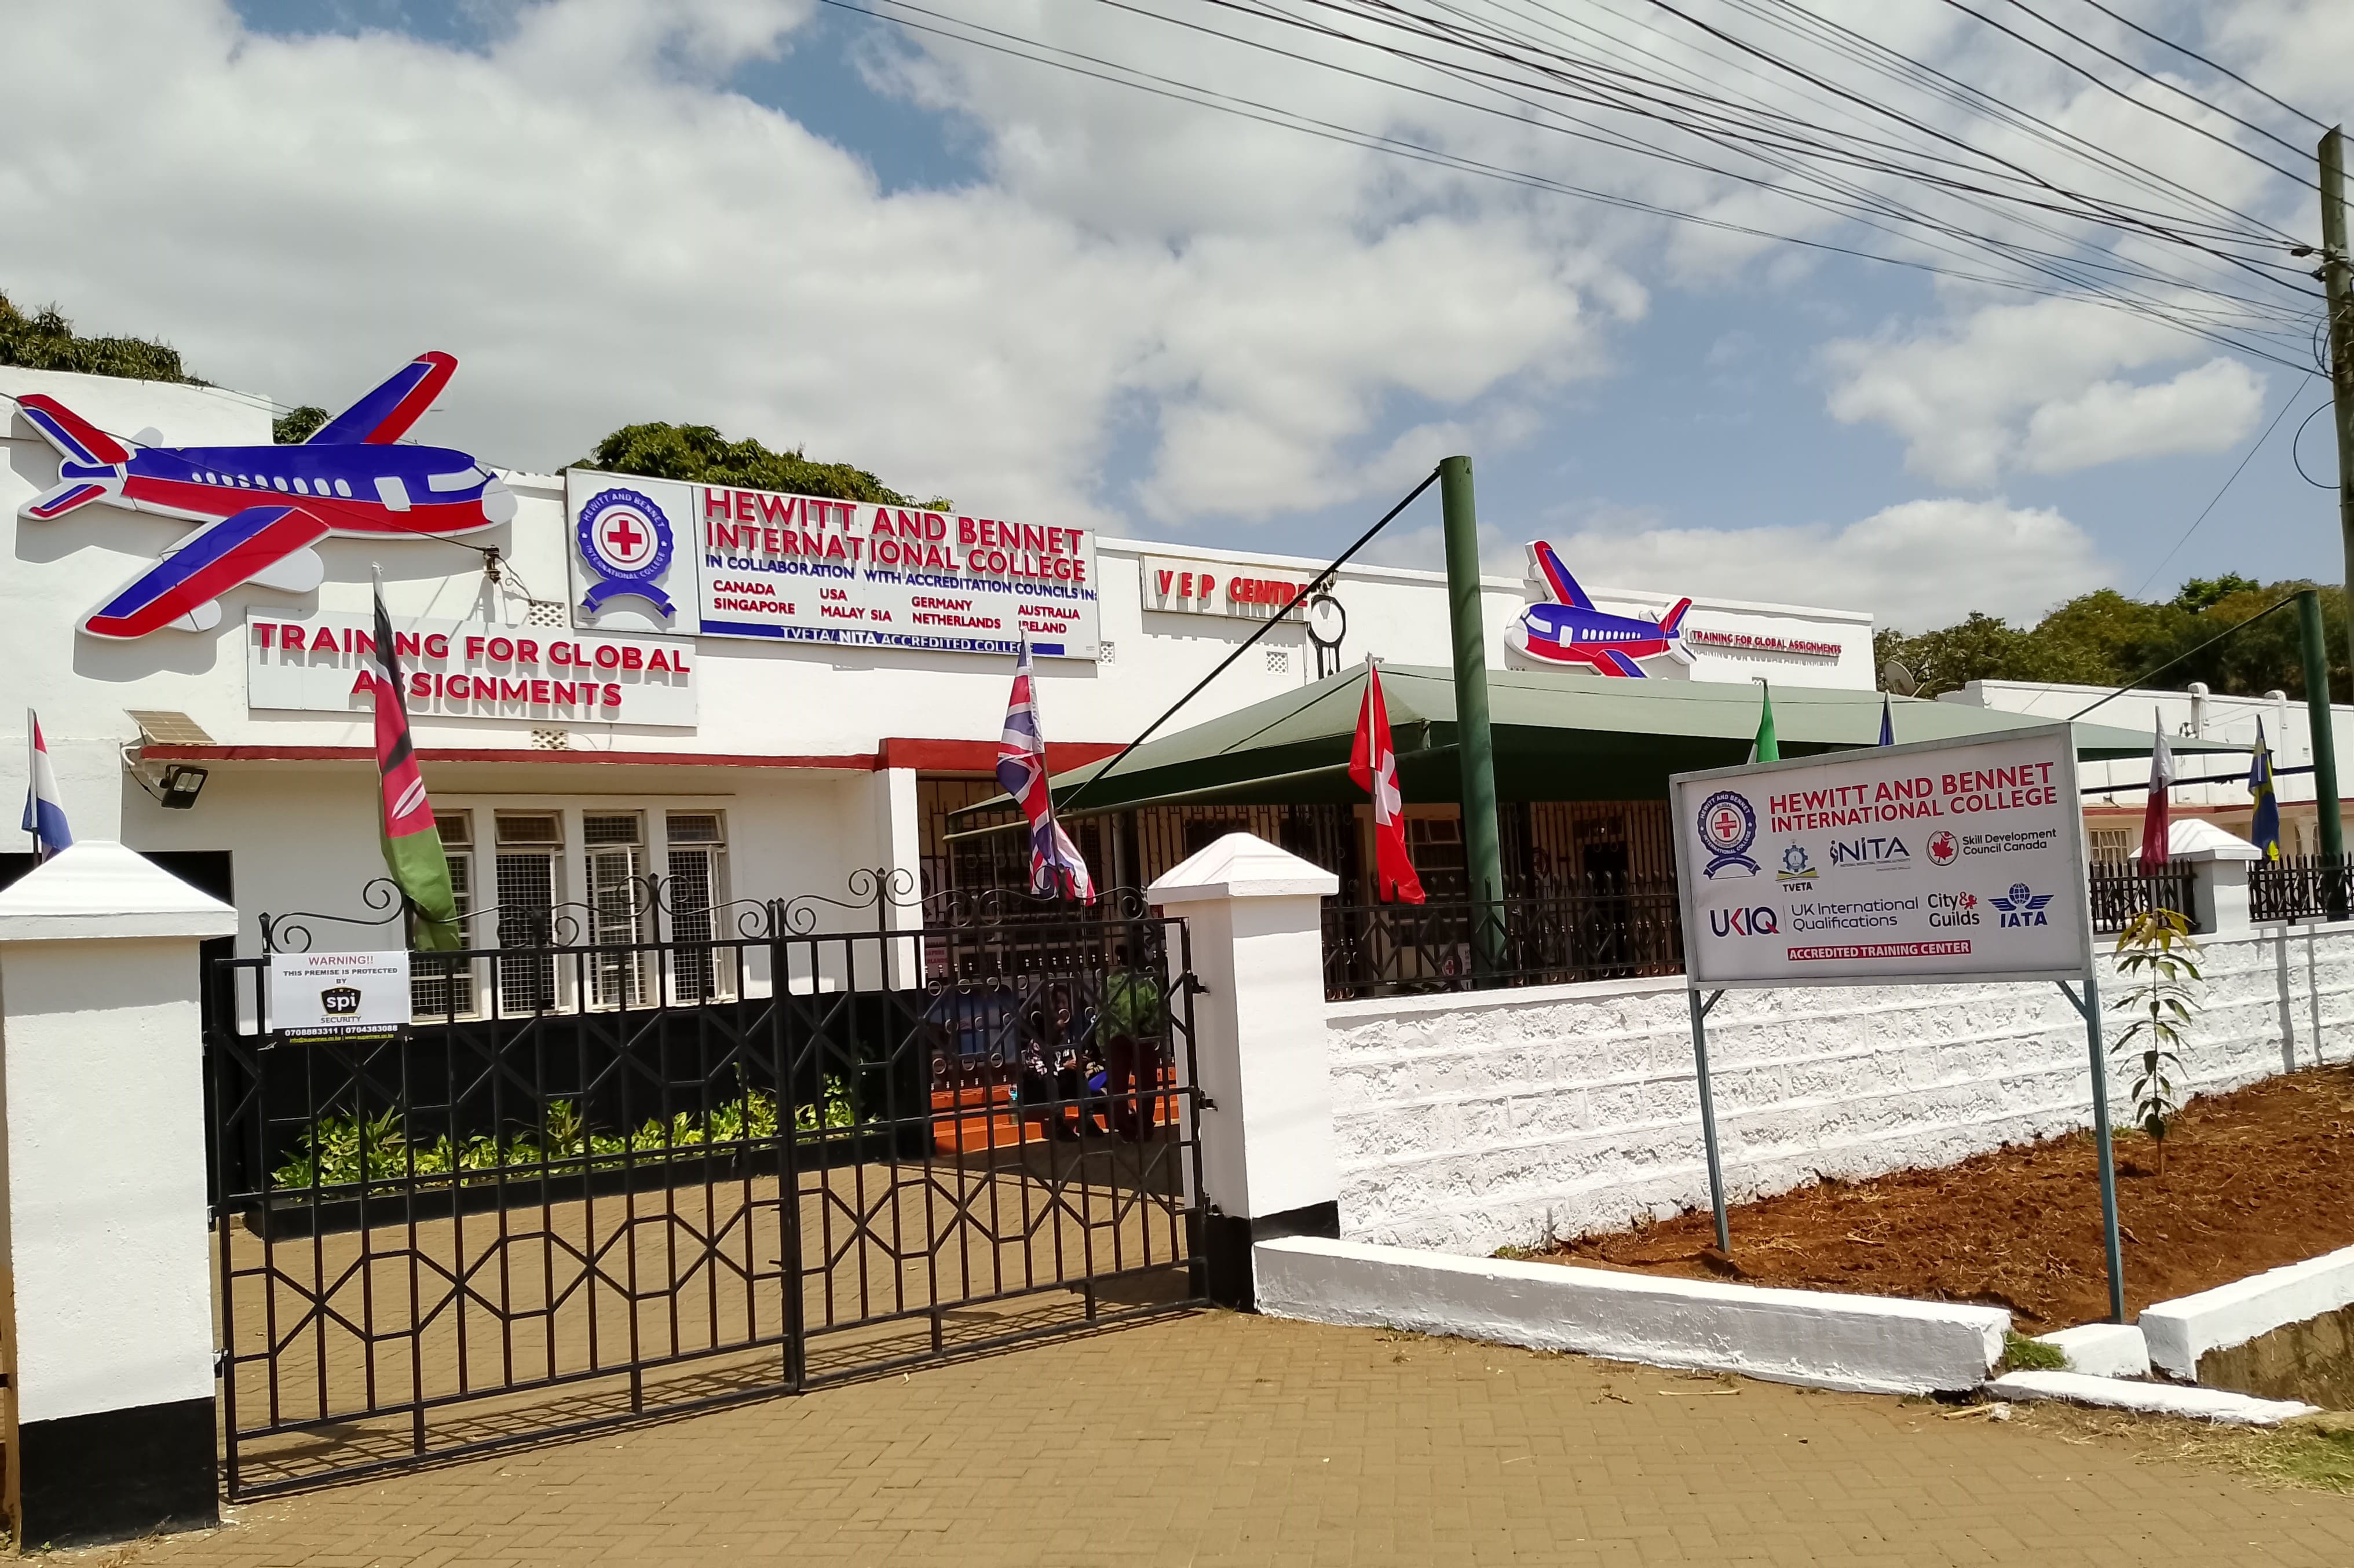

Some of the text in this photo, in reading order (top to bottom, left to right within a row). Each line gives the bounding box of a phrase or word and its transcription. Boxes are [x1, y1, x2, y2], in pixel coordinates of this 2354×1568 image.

[583, 493, 665, 528] HEWITT AND BENNET
[704, 488, 1084, 555] HEWITT AND BENNET
[706, 521, 1086, 582] INTERNATIONAL COLLEGE
[586, 544, 666, 580] INTERNATIONAL COLLEGE
[706, 554, 1098, 601] IN COLLABORATION WITH ACCREDITATION COUNCILS IN:
[713, 579, 776, 596] CANADA
[820, 587, 848, 602] USA
[714, 597, 795, 615] SINGAPORE
[911, 596, 973, 612] GERMANY
[1017, 604, 1081, 620] AUSTRALIA
[912, 612, 1001, 630] NETHERLANDS
[1018, 620, 1067, 634] IRELAND
[253, 622, 691, 674] TRAINNG FOR GLOBAL
[839, 630, 877, 645] NITA
[880, 634, 971, 650] ACCREDITED
[1691, 630, 1842, 654] TRAINING FOR GLOBAL ASSIGNMENTS
[351, 670, 623, 707] ASIGNMENTS
[1770, 762, 2054, 814] HEWITT AND BENNET
[1700, 798, 1715, 819] HEWITT
[1730, 795, 1750, 814] BENNET
[1771, 786, 2057, 833] INTERNATIONAL COLLEGE
[1703, 830, 1752, 854] INTERNATIONAL COLLEGE
[1962, 828, 2057, 845] Skill Development
[1963, 840, 2047, 855] Council Canada
[1782, 882, 1813, 893] TVETA
[1791, 896, 1919, 916] UK International
[1709, 906, 1781, 937] UKIQ
[1793, 914, 1898, 932] Qualifications
[1929, 911, 1980, 927] Guilds
[2001, 911, 2048, 928] IATA
[1789, 942, 1969, 959] ACCREDITED TRAINING CENTER
[308, 956, 374, 966] WARNING!!
[326, 992, 357, 1011] spi
[320, 1015, 361, 1024] SECURITY
